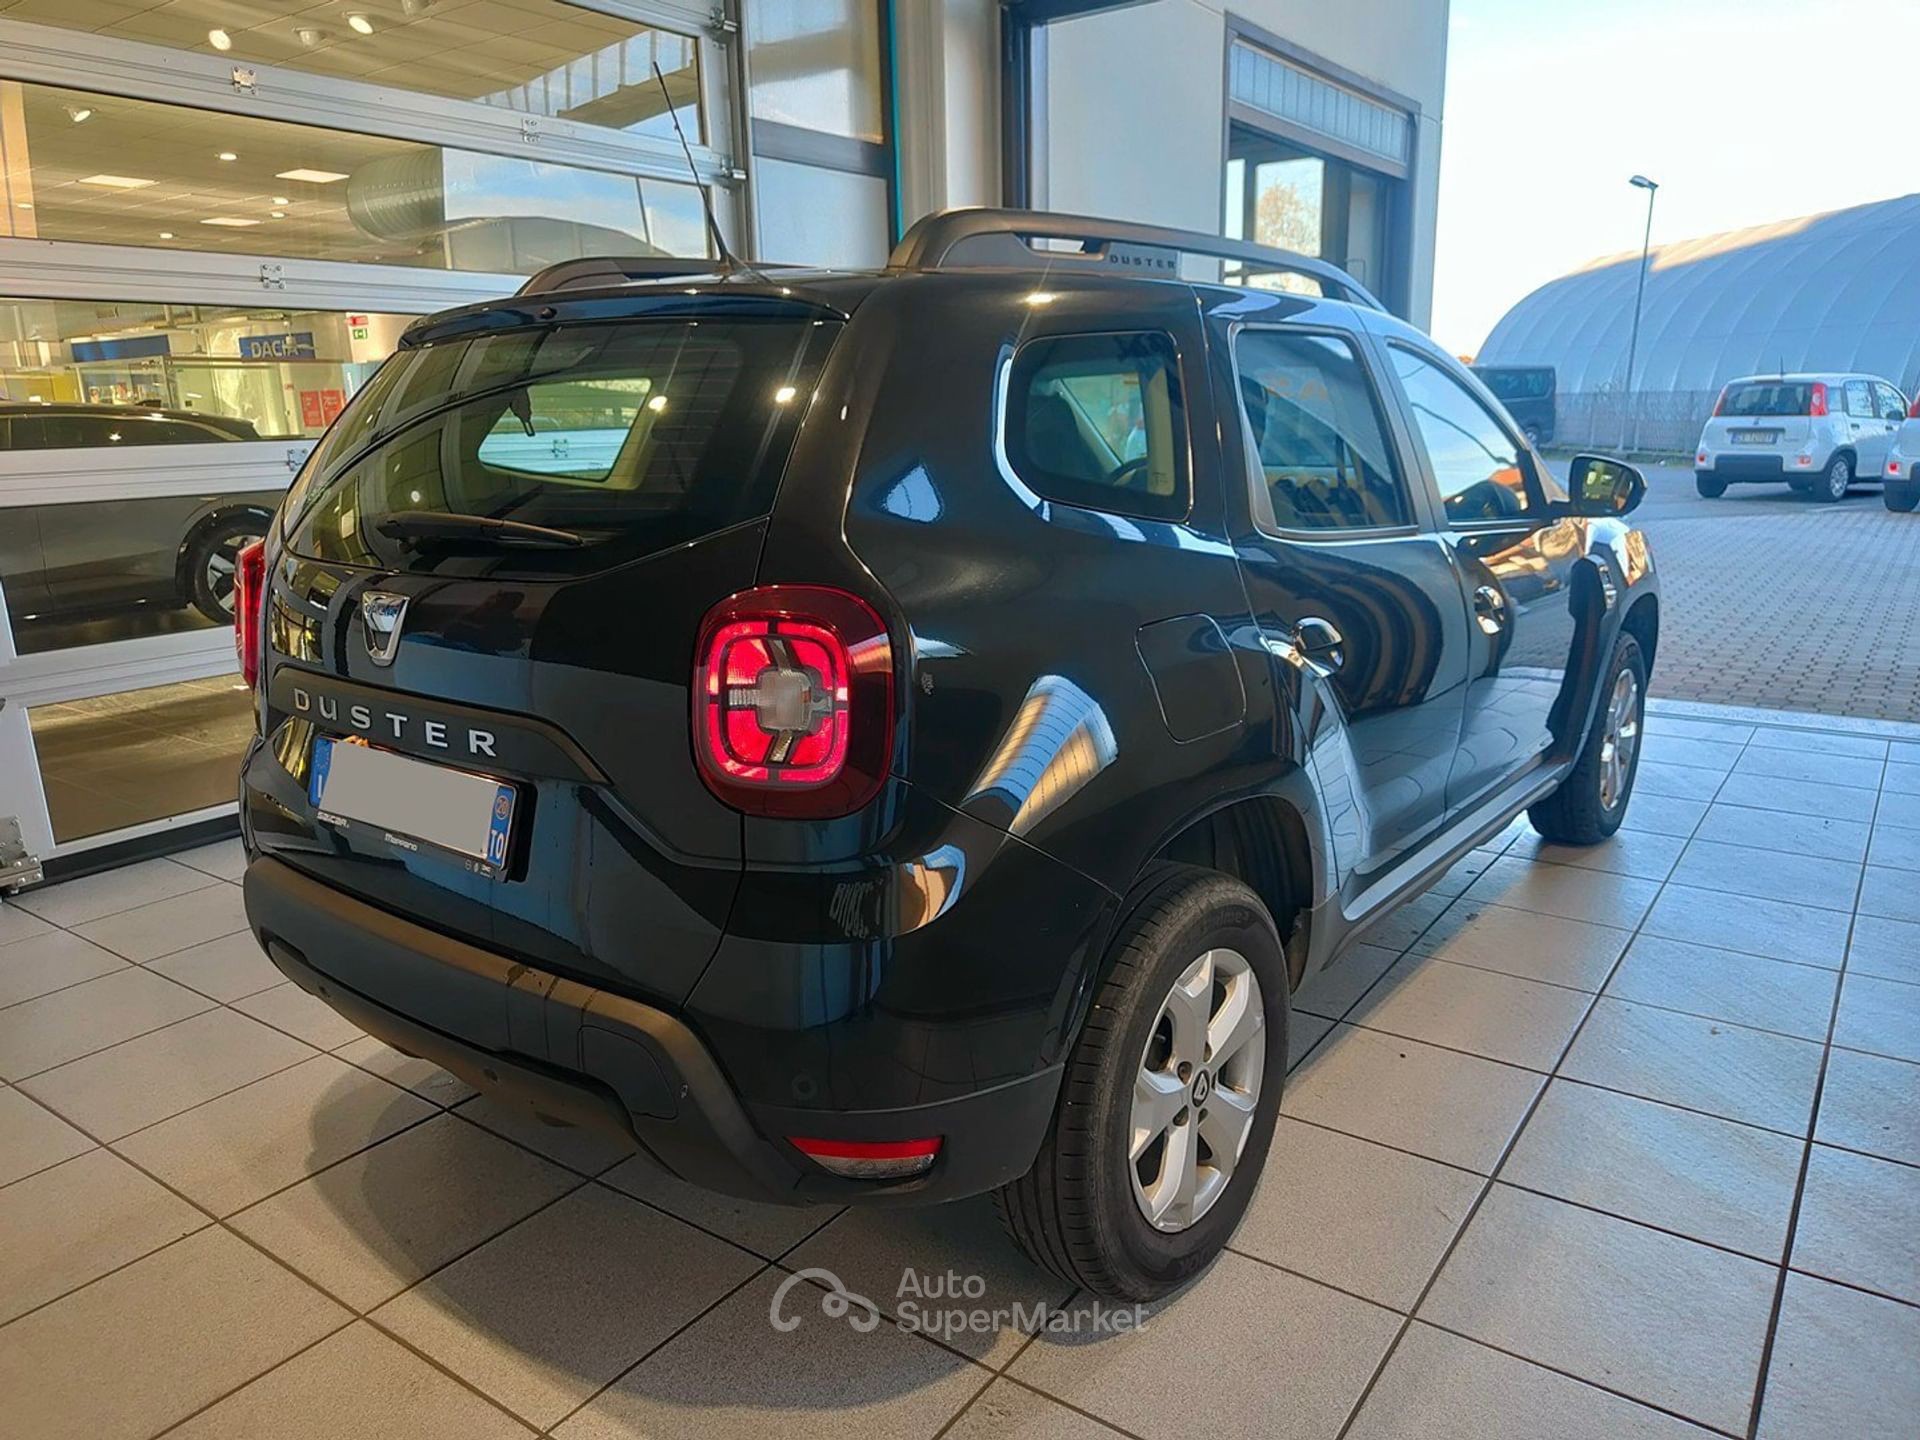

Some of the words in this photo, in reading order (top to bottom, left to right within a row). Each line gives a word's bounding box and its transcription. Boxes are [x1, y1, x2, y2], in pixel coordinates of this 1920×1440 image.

[1110, 254, 1176, 269] DUSTER
[293, 688, 497, 757] DUSTER
[490, 829, 505, 860] TO
